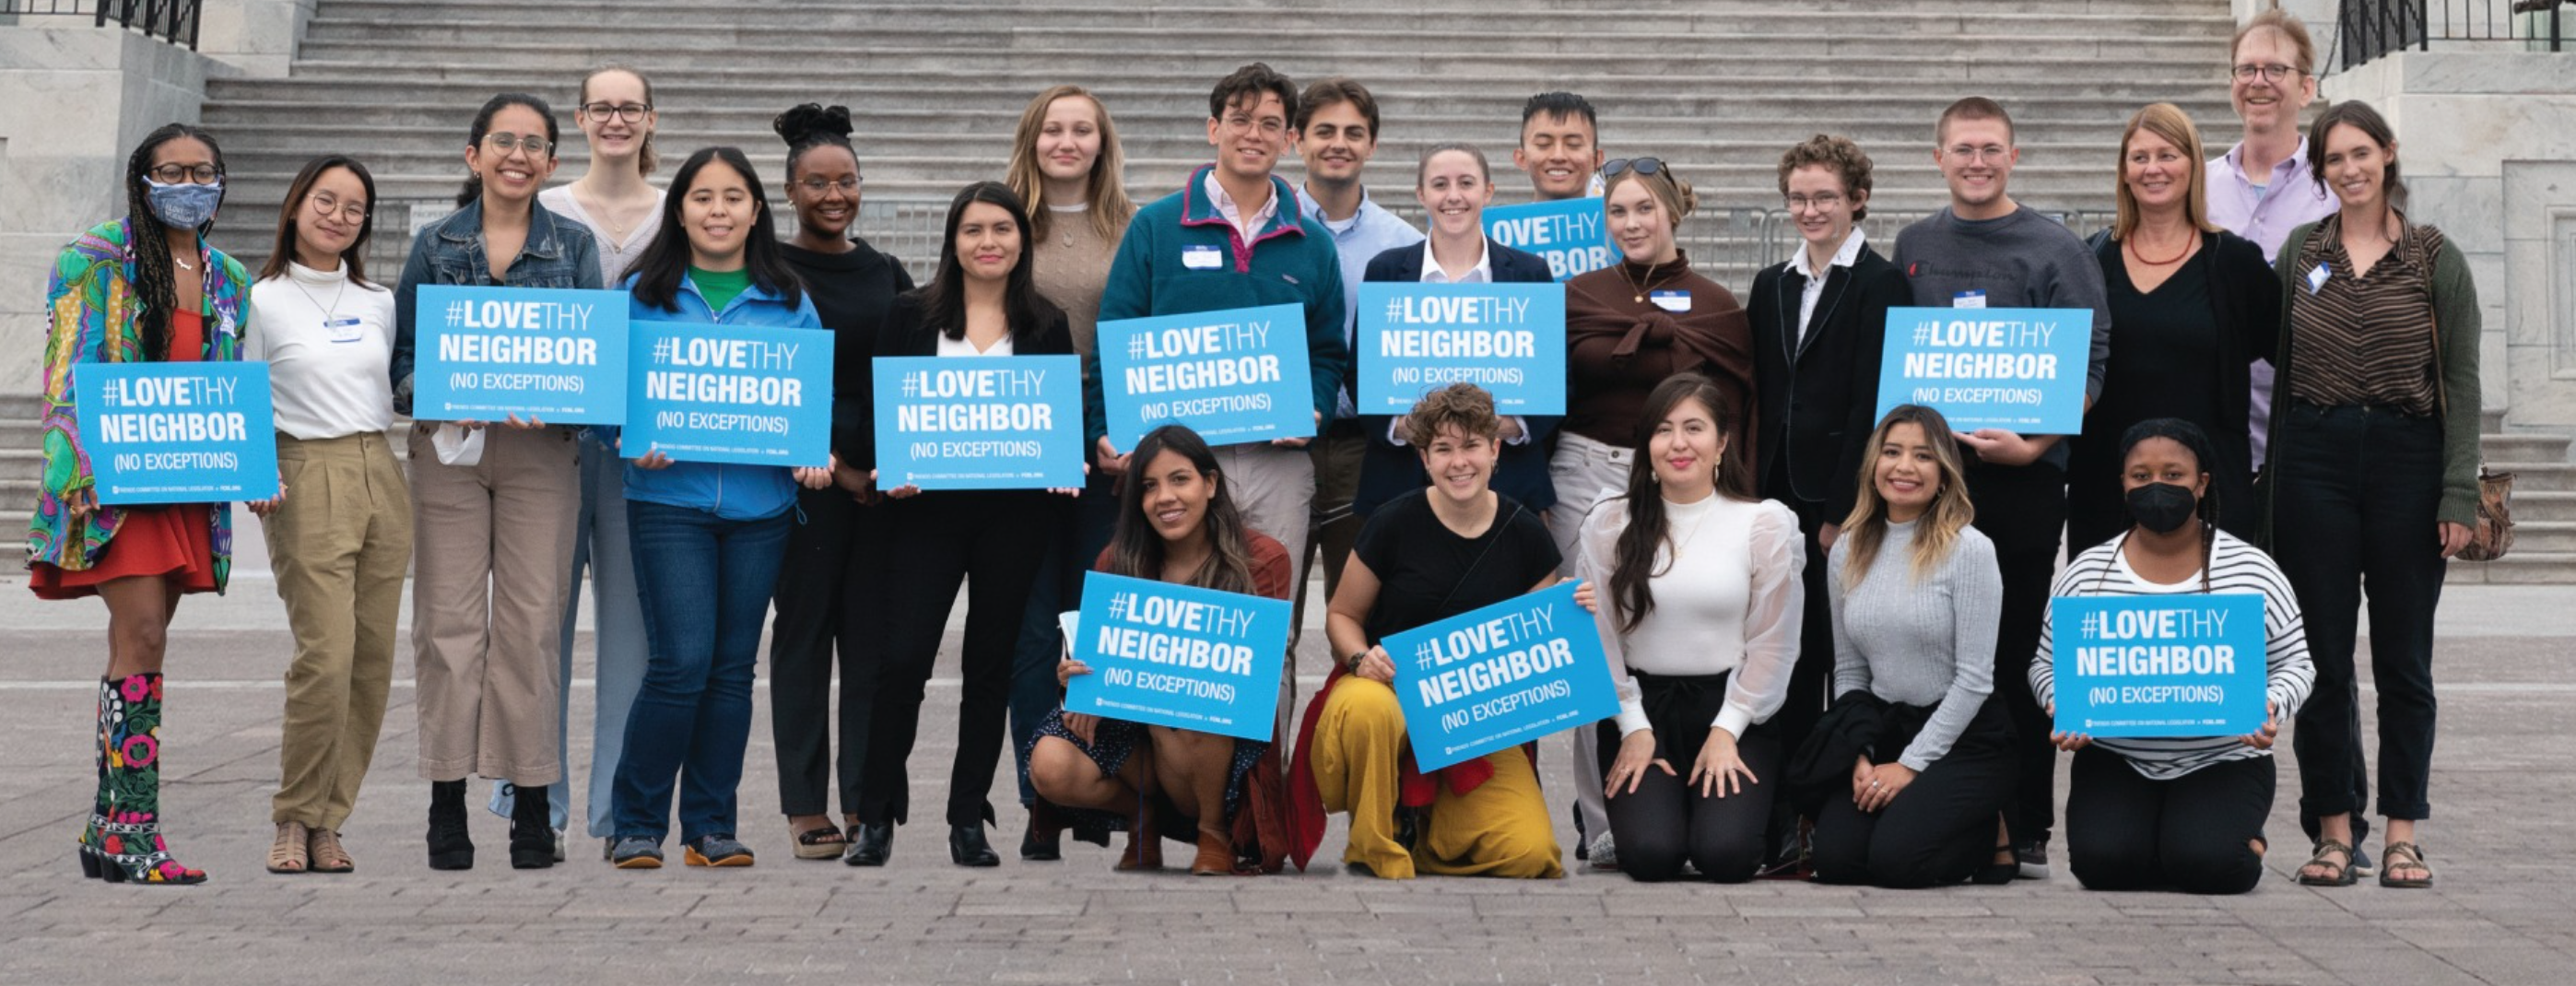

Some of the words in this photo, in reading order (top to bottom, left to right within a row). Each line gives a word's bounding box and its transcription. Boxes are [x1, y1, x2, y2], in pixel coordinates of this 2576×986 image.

[1491, 211, 1600, 248] OVETHY
[446, 299, 593, 330] #LOVETHY
[1386, 296, 1528, 323] #LOVETHY
[1128, 321, 1269, 359] #LOVETHY
[1382, 330, 1534, 358] NEIGHBOR
[1912, 320, 2056, 347] #LOVETHY
[440, 334, 596, 365] NEIGHBOR
[653, 336, 798, 370] #LOVETHY
[1125, 355, 1280, 394] NEIGHBOR
[1393, 367, 1419, 384] (NO
[1425, 367, 1523, 385] EXCEPTIONS)
[1904, 353, 2057, 379] NEIGHBOR
[102, 376, 237, 406] #LOVETHY
[450, 372, 477, 391] (NO
[484, 373, 584, 393] EXCEPTIONS)
[647, 371, 801, 406] NEIGHBOR
[902, 370, 1045, 398] #LOVETHY
[1913, 388, 1939, 404] (NO
[1945, 388, 2042, 406] EXCEPTIONS)
[899, 403, 1052, 431] NEIGHBOR
[1141, 403, 1168, 422] (NO
[1172, 393, 1271, 417] EXCEPTIONS)
[100, 412, 246, 442] NEIGHBOR
[657, 411, 684, 429] (NO
[689, 412, 788, 436] EXCEPTIONS)
[114, 452, 140, 473] (NO
[145, 452, 238, 472] EXCEPTIONS)
[911, 442, 937, 461] (NO
[943, 440, 1041, 459] EXCEPTIONS)
[1109, 592, 1255, 639] #LOVETHY
[2080, 609, 2229, 640] #LOVETHY
[1098, 626, 1253, 675] NEIGHBOR
[1415, 603, 1553, 671] #LOVETHY
[1417, 638, 1574, 708] NEIGHBOR
[2077, 645, 2235, 675] NEIGHBOR
[1104, 667, 1133, 687] (NO
[1136, 672, 1236, 704] EXCEPTIONS)
[2089, 687, 2117, 708] (NO
[2122, 685, 2223, 705] EXCEPTIONS)
[1442, 709, 1469, 734] (NO
[1472, 680, 1570, 722] EXCEPTIONS)
